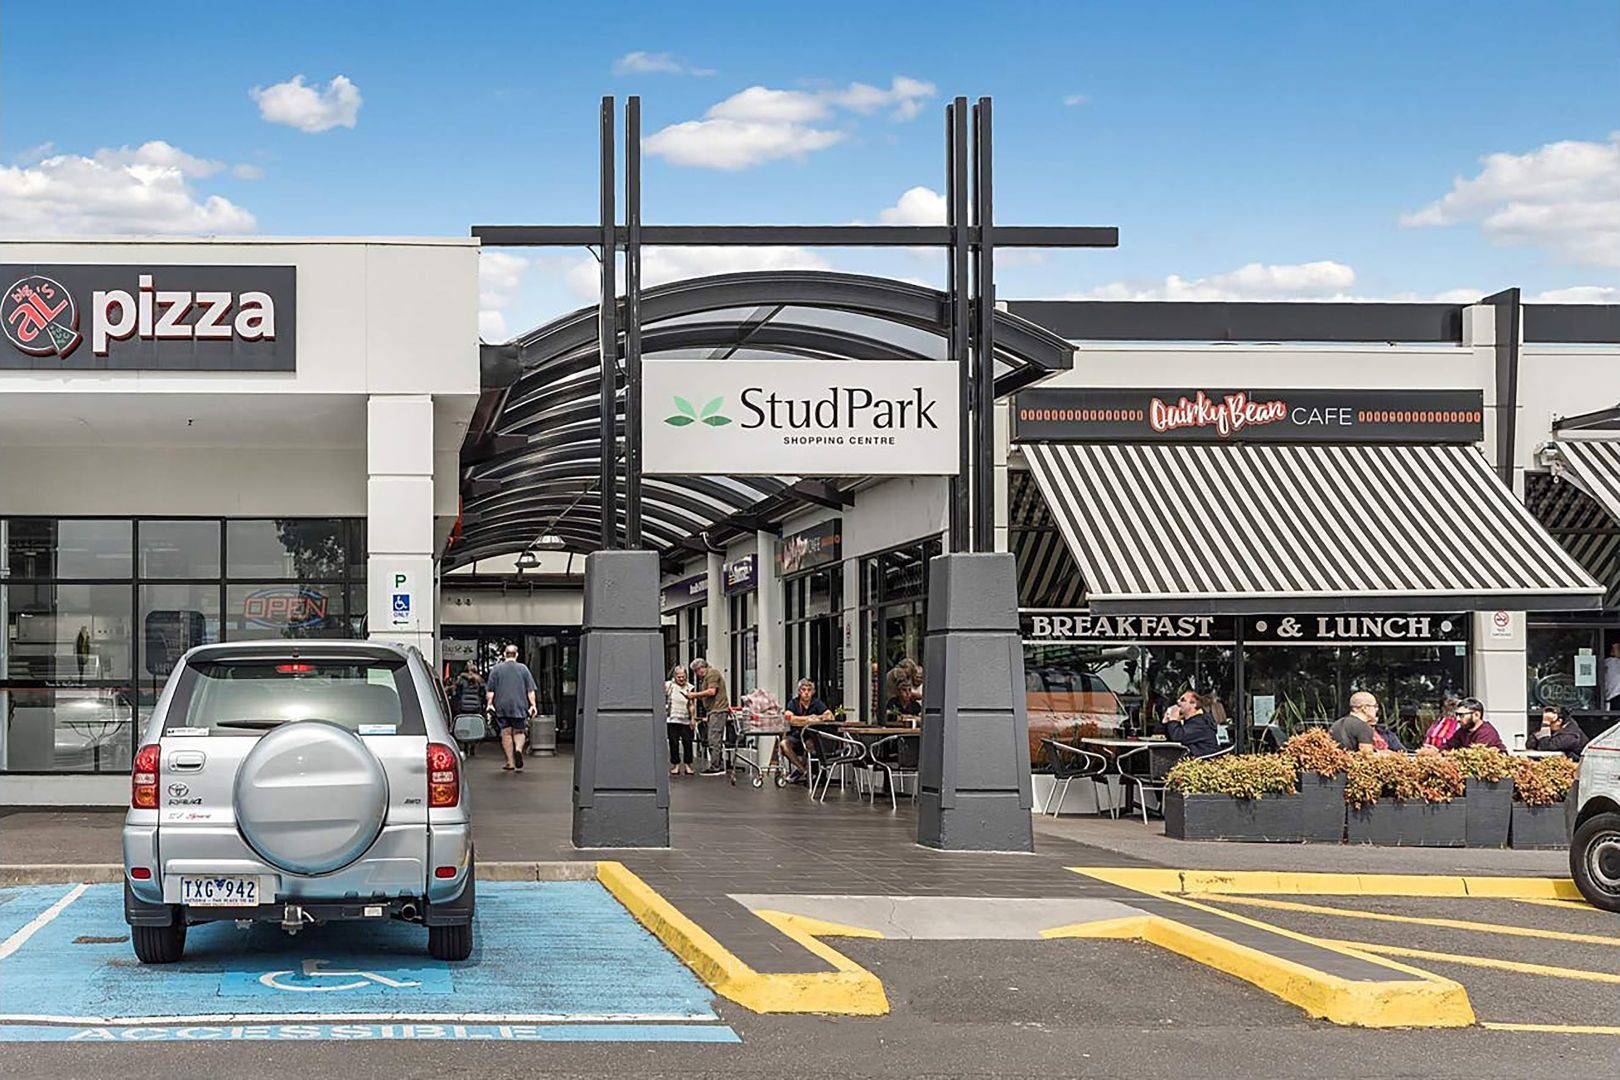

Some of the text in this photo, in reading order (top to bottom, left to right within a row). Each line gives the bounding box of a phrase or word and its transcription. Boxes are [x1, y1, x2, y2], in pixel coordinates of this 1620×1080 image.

[92, 275, 275, 356] pizza
[1291, 407, 1353, 425] CAFE
[783, 436, 896, 445] SHOPPING CENTRE
[395, 574, 407, 588] P
[244, 596, 328, 619] OPEN
[1031, 615, 1431, 638] BREAKFAST & LUNCH
[184, 880, 255, 898] TXG 942
[67, 1024, 543, 1041] ACCESSIBLE
